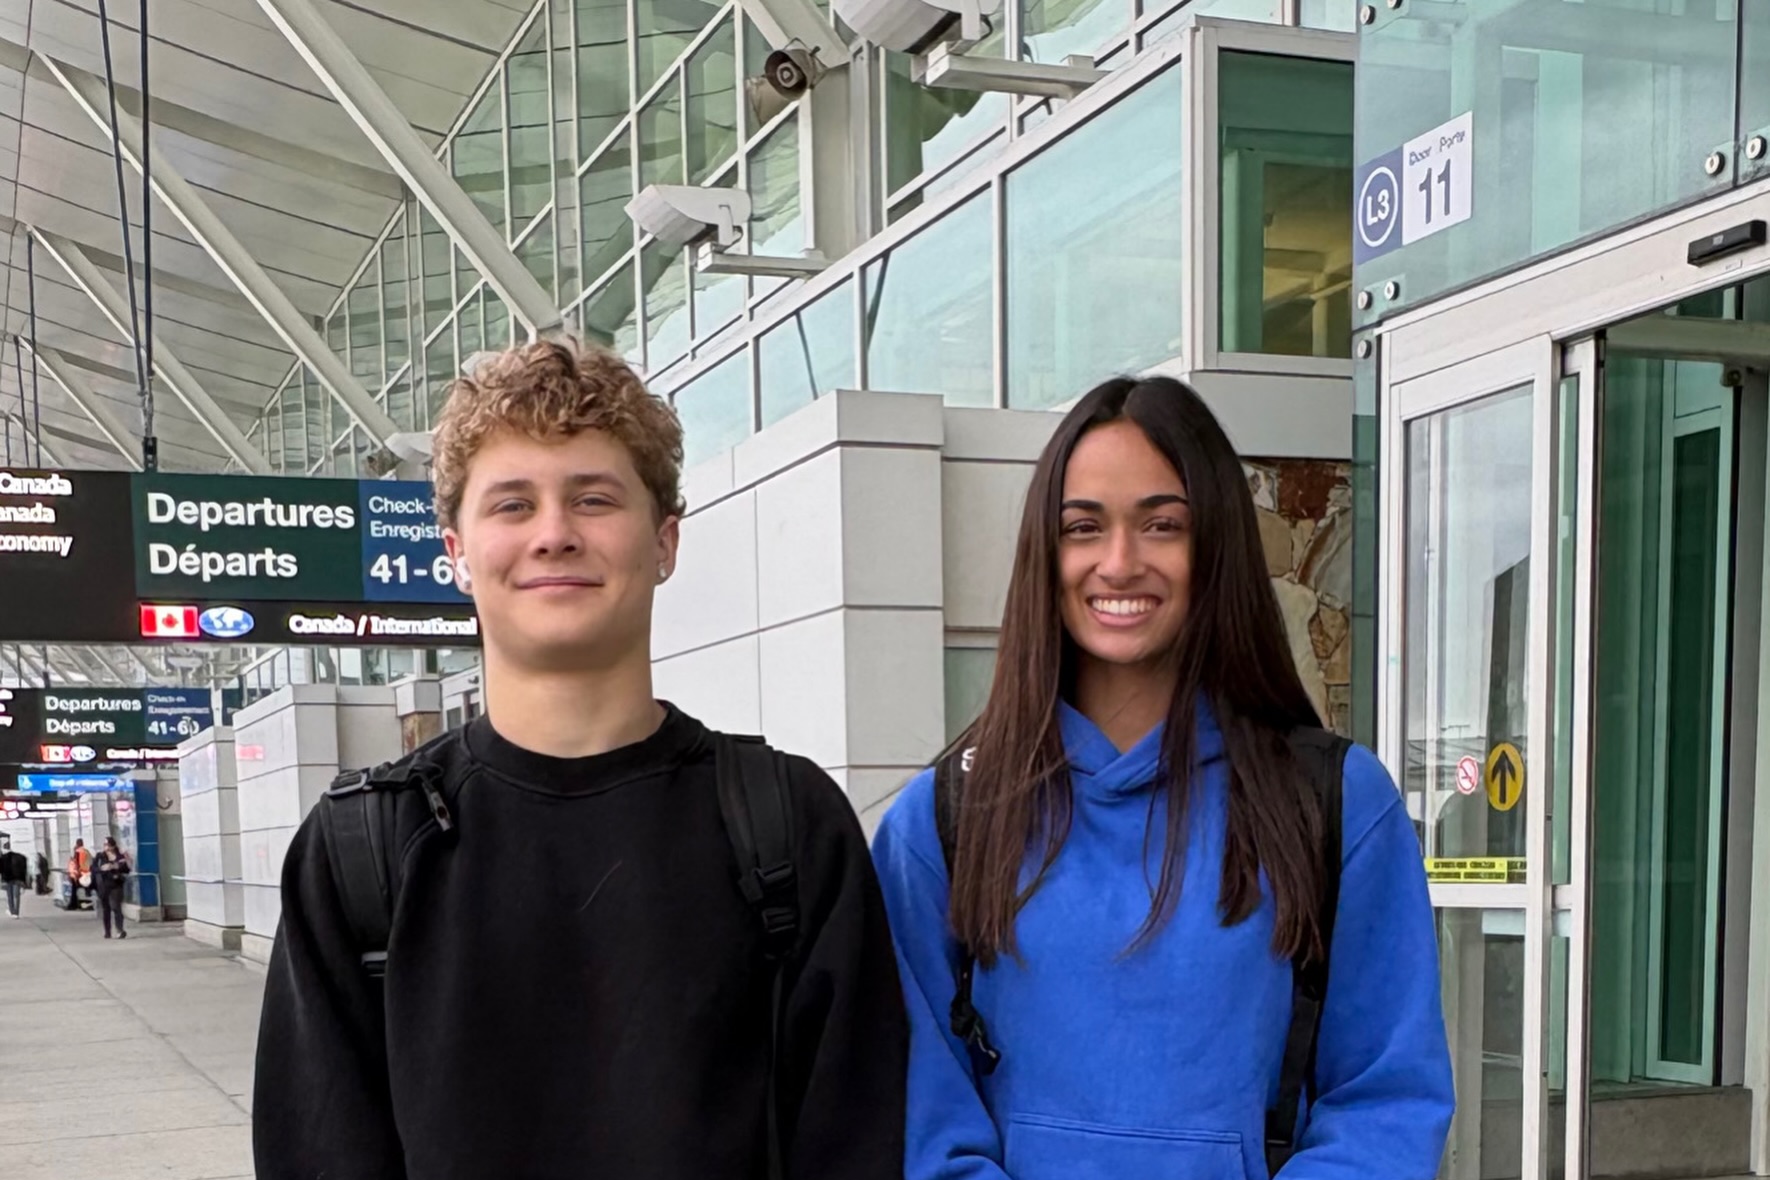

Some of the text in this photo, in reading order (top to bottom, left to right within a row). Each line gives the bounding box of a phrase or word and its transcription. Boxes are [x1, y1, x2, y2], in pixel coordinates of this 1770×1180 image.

[1366, 189, 1390, 226] L3
[1418, 158, 1451, 224] 11
[147, 492, 355, 531] Departures
[368, 495, 434, 514] Check-
[370, 520, 442, 542] Enregist
[149, 543, 298, 582] Départs
[370, 553, 454, 585] 41-6
